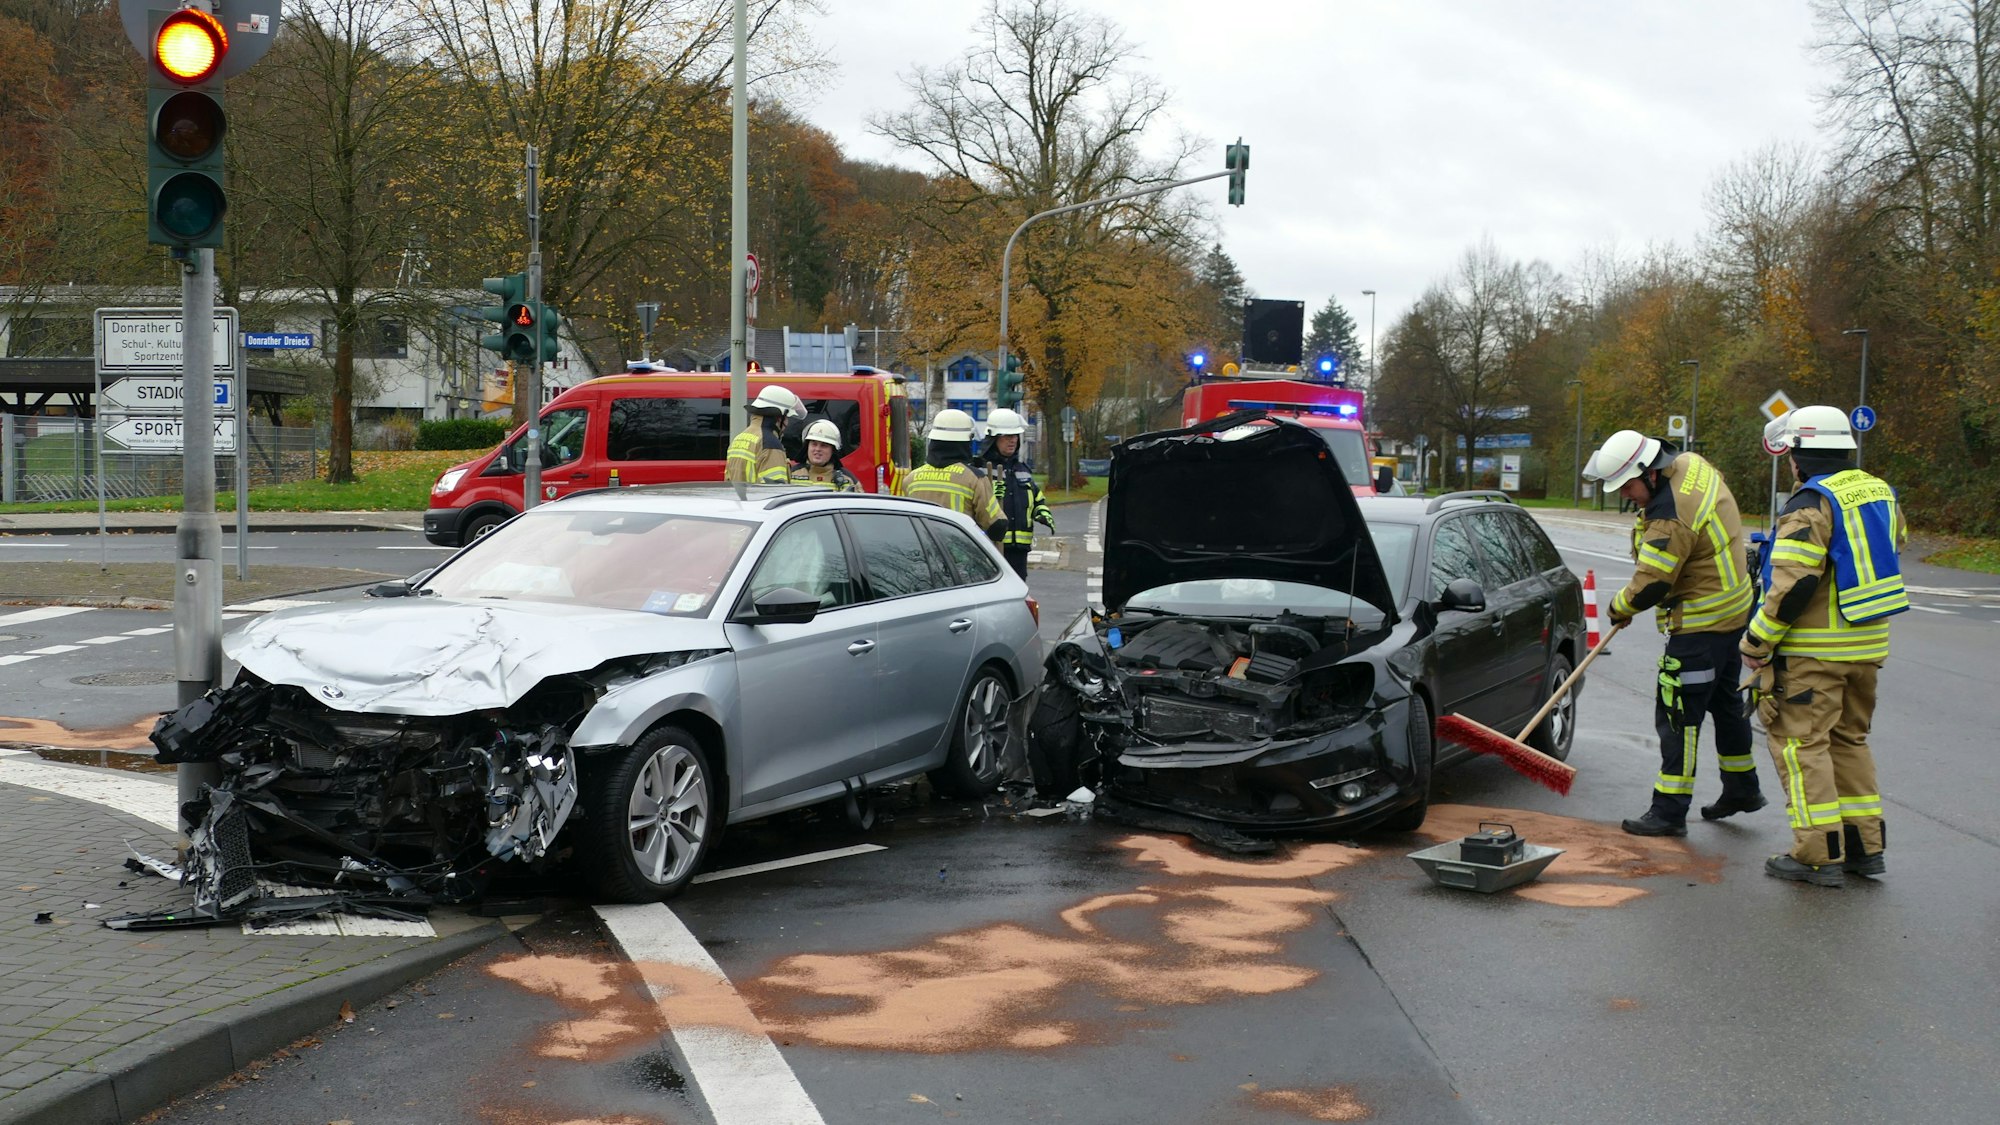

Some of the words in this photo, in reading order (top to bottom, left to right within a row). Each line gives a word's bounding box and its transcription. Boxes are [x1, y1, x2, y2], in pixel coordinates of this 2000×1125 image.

[112, 322, 171, 333] Donrather
[157, 339, 184, 349] Kultu
[248, 335, 282, 346] Donrather
[284, 335, 310, 346] Dreieck
[134, 351, 184, 363] Sportzentr
[913, 472, 951, 481] LOHMAR
